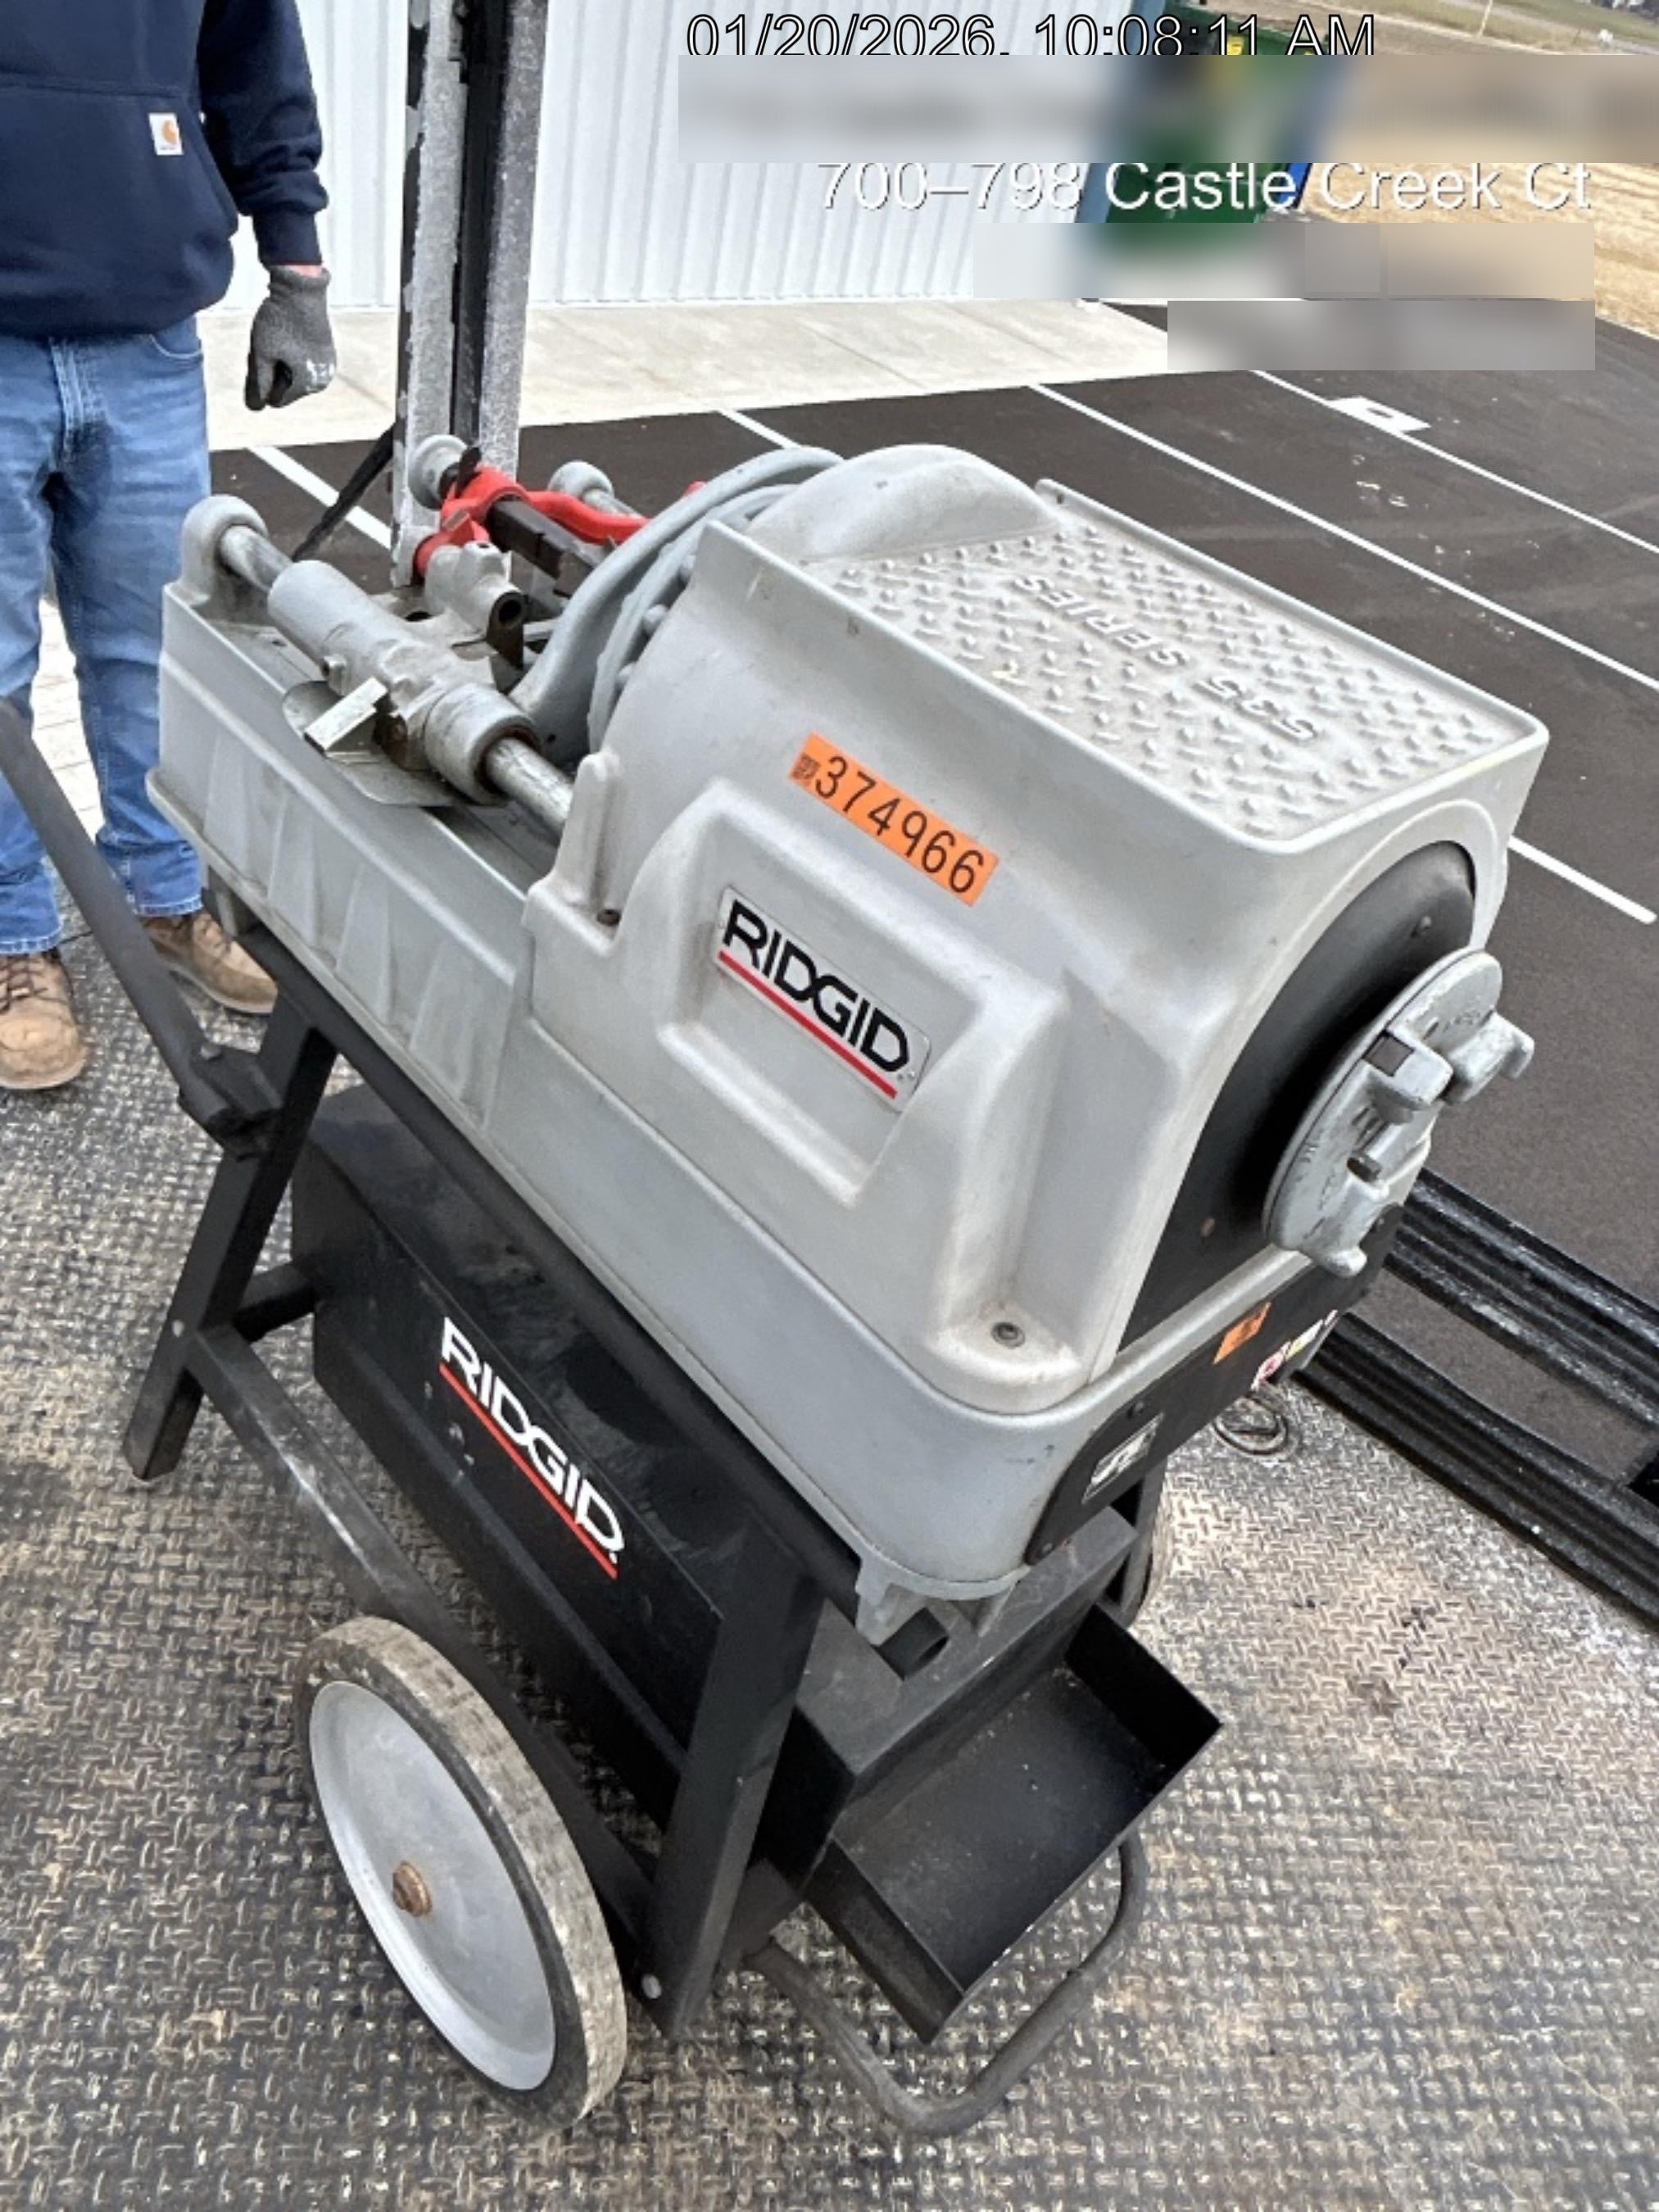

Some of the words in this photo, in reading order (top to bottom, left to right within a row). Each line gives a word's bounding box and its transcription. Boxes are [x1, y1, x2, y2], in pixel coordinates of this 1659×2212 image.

[1011, 576, 1190, 669] SERIES
[815, 755, 984, 895] 374966
[722, 899, 910, 1073] RIDGID
[441, 1316, 625, 1552] RIDGID
